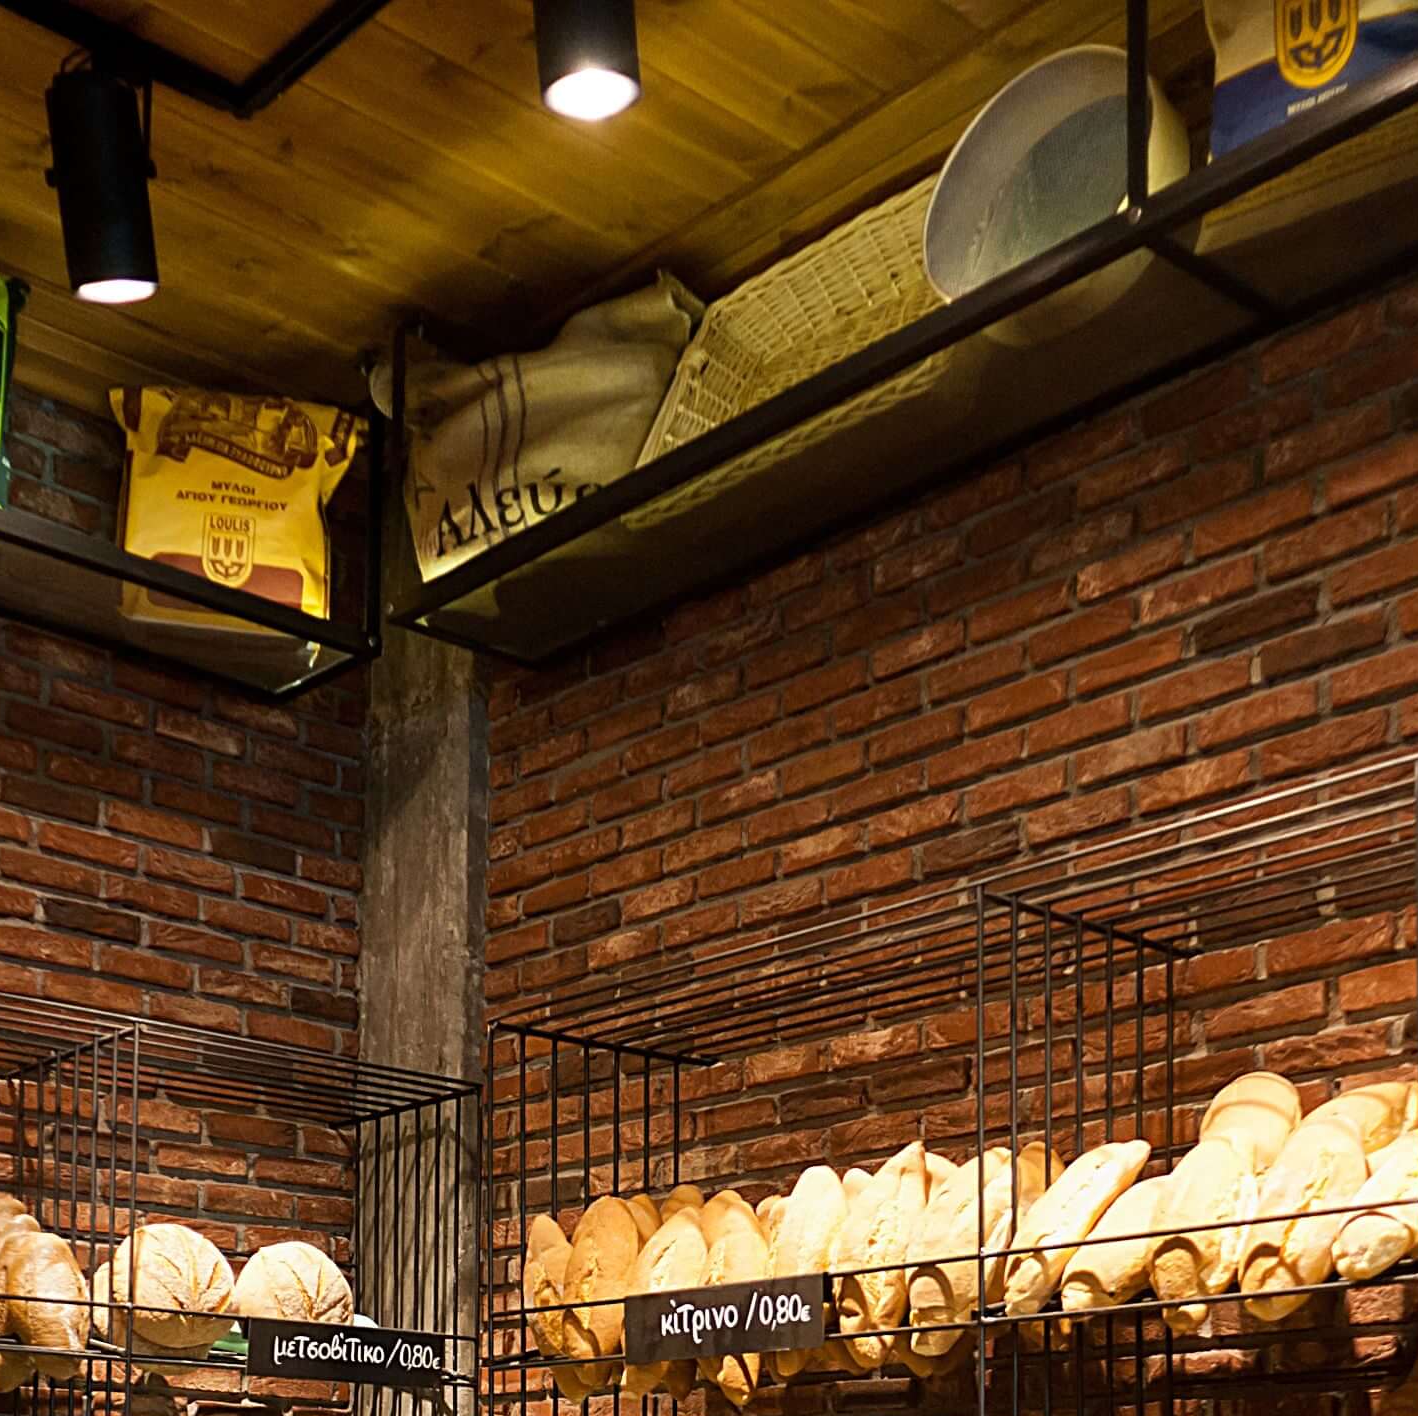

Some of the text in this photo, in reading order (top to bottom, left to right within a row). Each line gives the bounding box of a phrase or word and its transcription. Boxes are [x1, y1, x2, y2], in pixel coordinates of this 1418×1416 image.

[175, 488, 289, 512] ΑΓΙΟΥ ΓΕΩΡΓΙΟΥ
[210, 480, 257, 496] ΜΥΛΟΙ
[209, 514, 251, 533] LOULIS
[660, 1299, 739, 1345] κίτρινο
[273, 1331, 385, 1366] μετσοβίτικο
